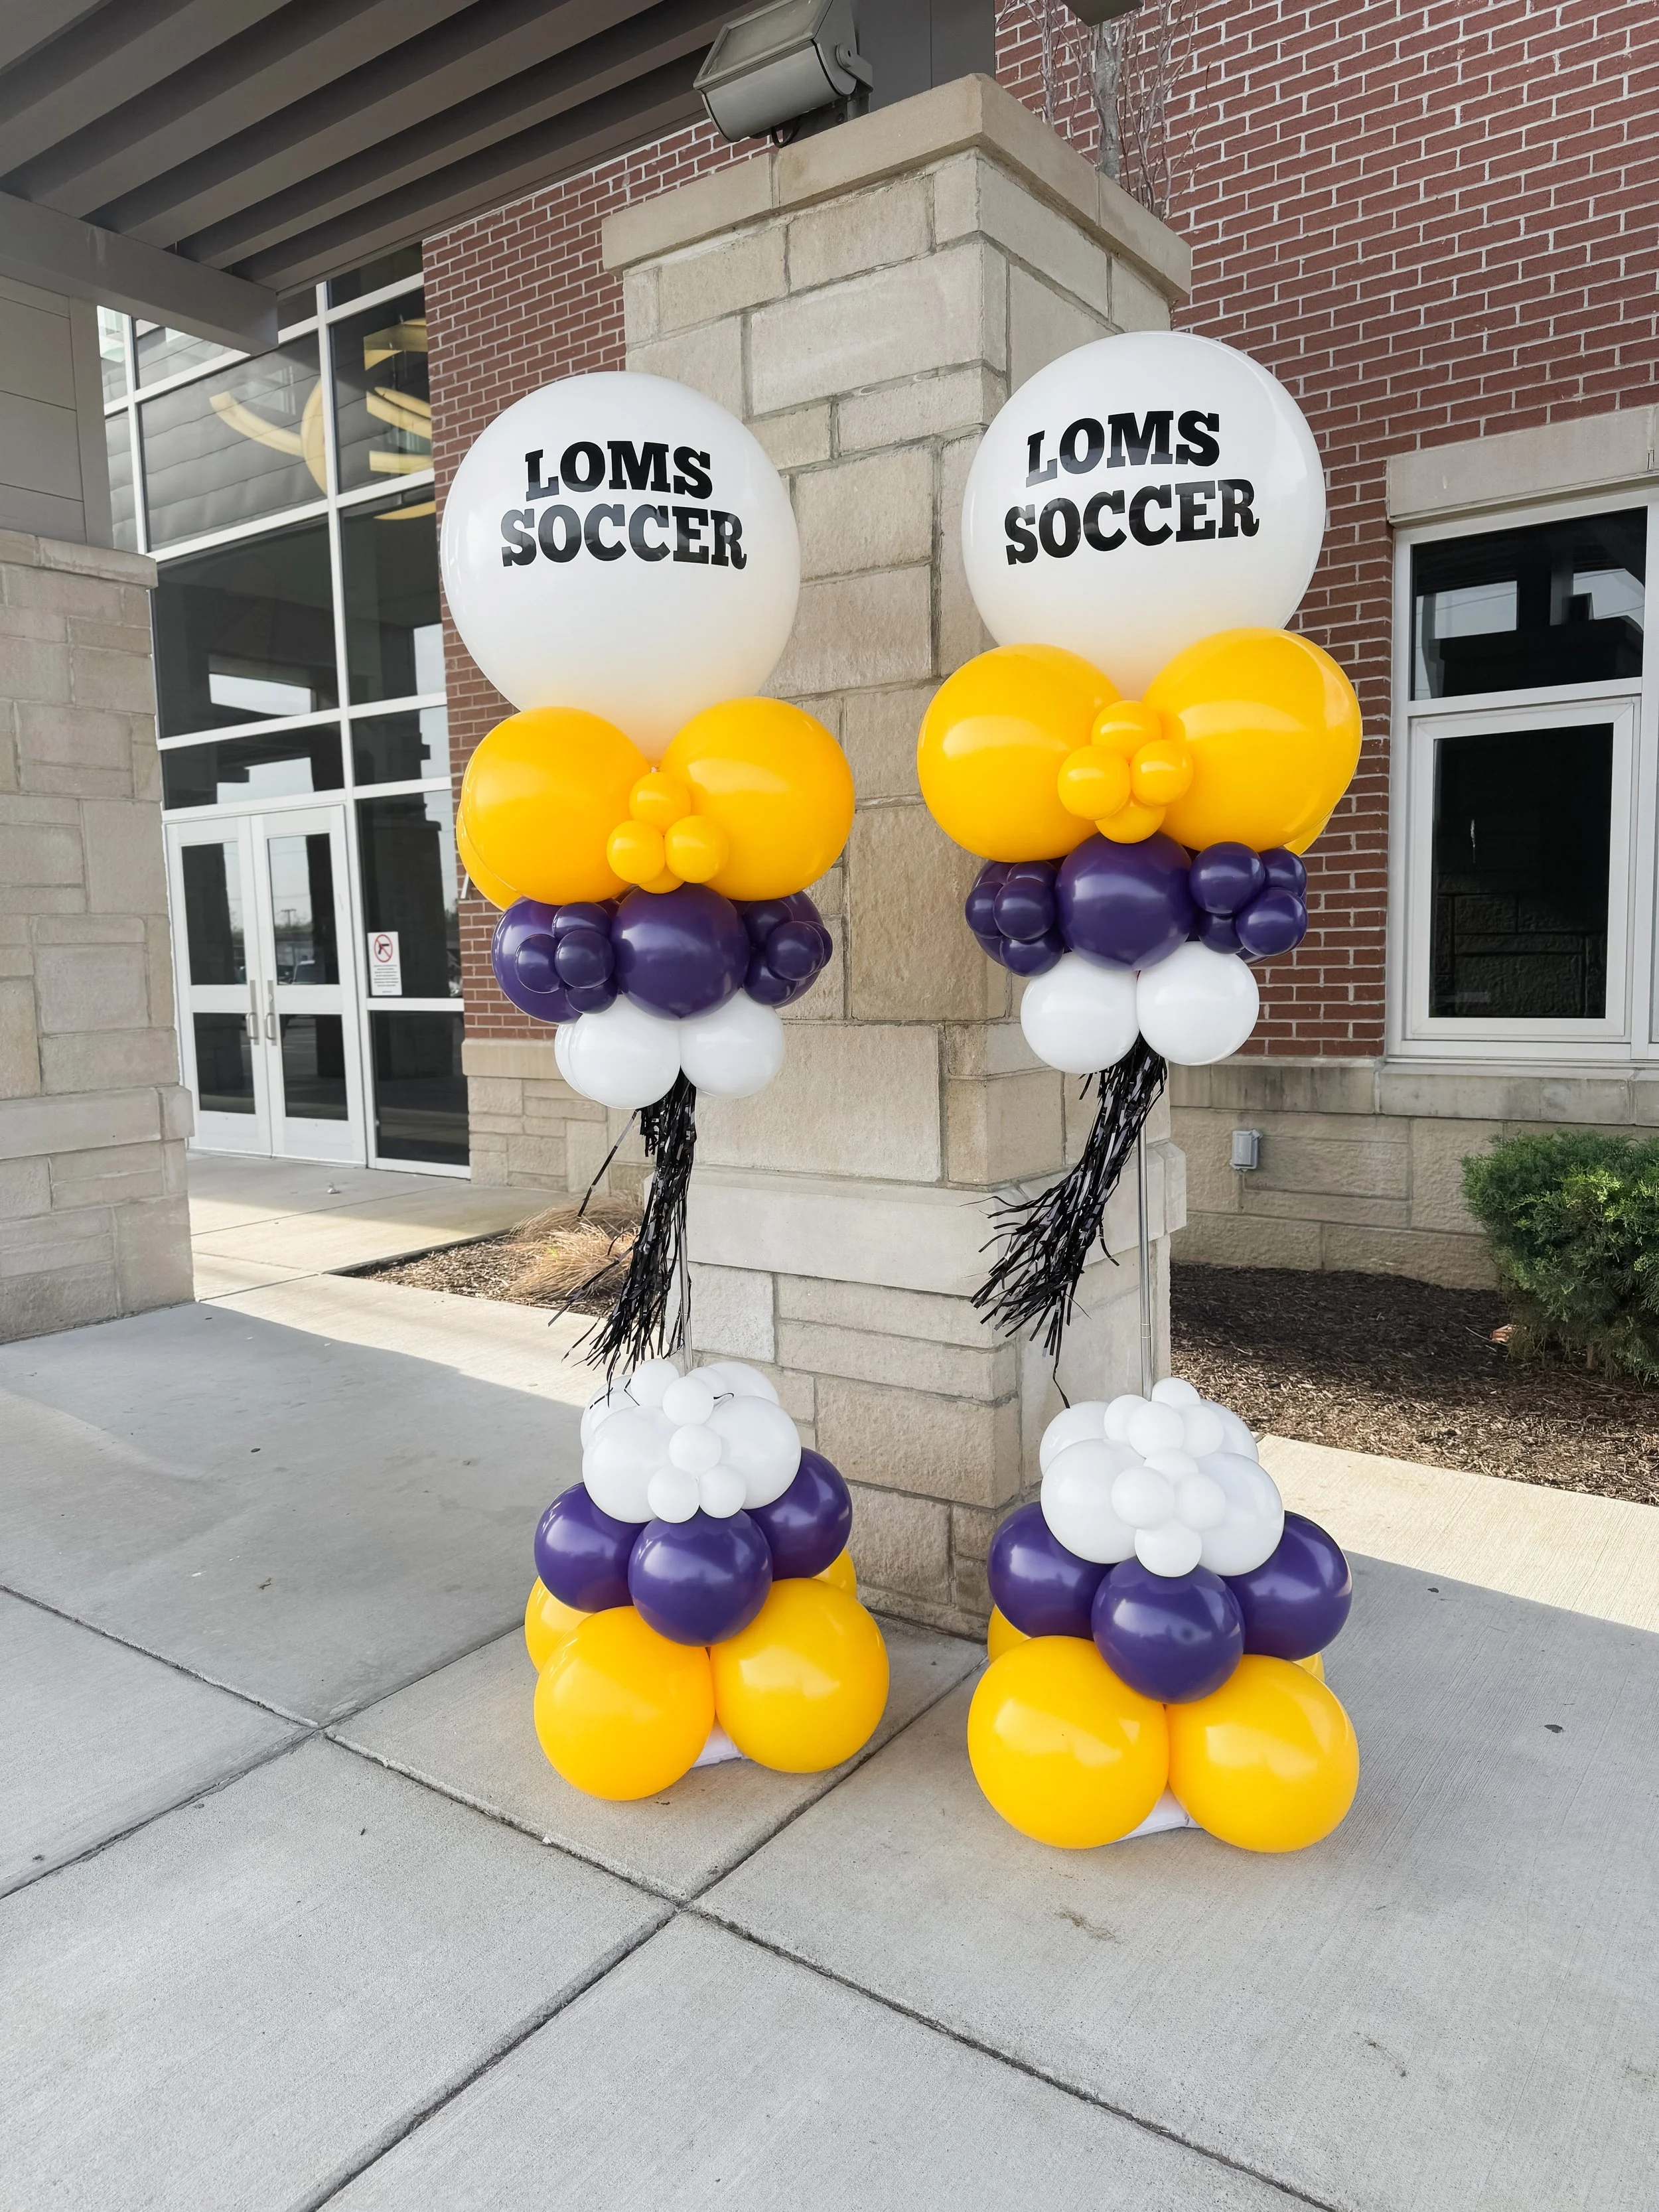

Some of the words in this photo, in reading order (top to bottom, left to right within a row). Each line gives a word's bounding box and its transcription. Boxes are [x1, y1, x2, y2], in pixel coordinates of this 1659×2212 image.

[525, 441, 713, 501] LOMS
[1026, 410, 1220, 487] LOMS
[500, 504, 747, 569] SOCCER
[1004, 479, 1260, 565] SOCCER
